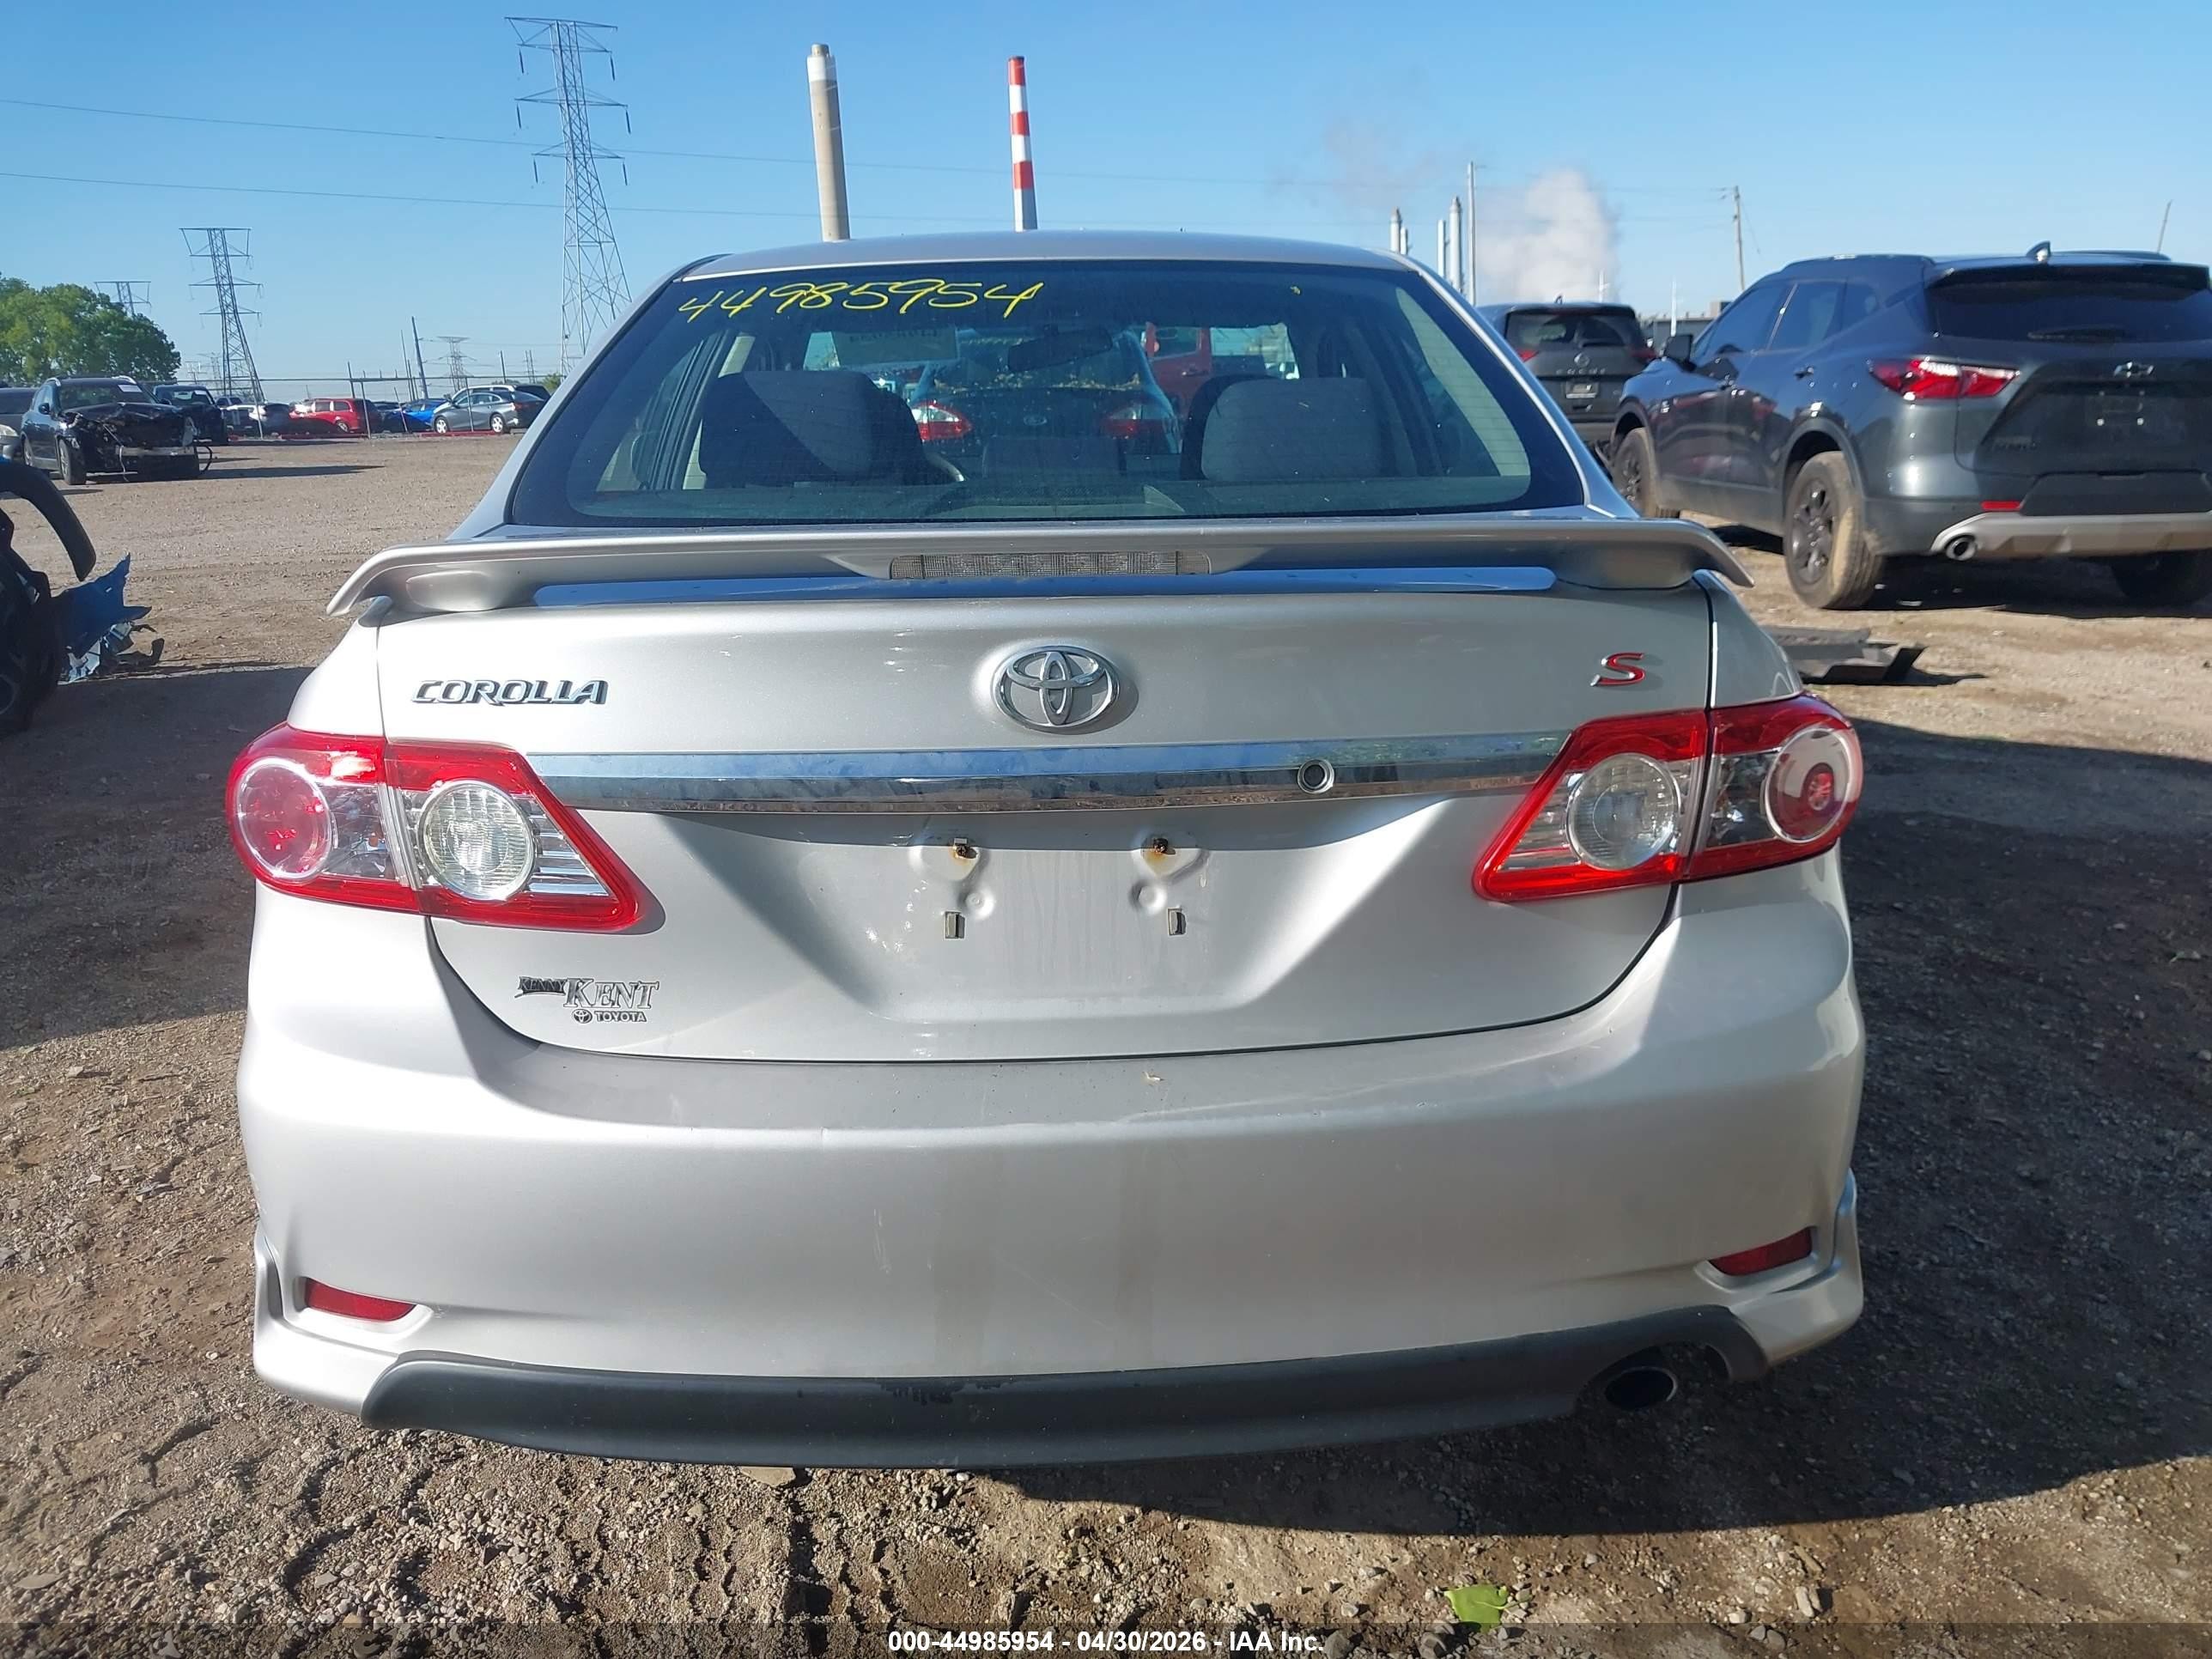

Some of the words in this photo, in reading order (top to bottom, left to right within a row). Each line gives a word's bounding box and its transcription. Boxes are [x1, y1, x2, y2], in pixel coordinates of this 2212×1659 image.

[678, 278, 1043, 323] 44985954
[1589, 652, 1646, 688] S
[411, 680, 609, 706] COROLLA
[517, 975, 567, 994] KENNY
[563, 977, 659, 1009] KENT
[595, 1011, 647, 1022] TOYOTA
